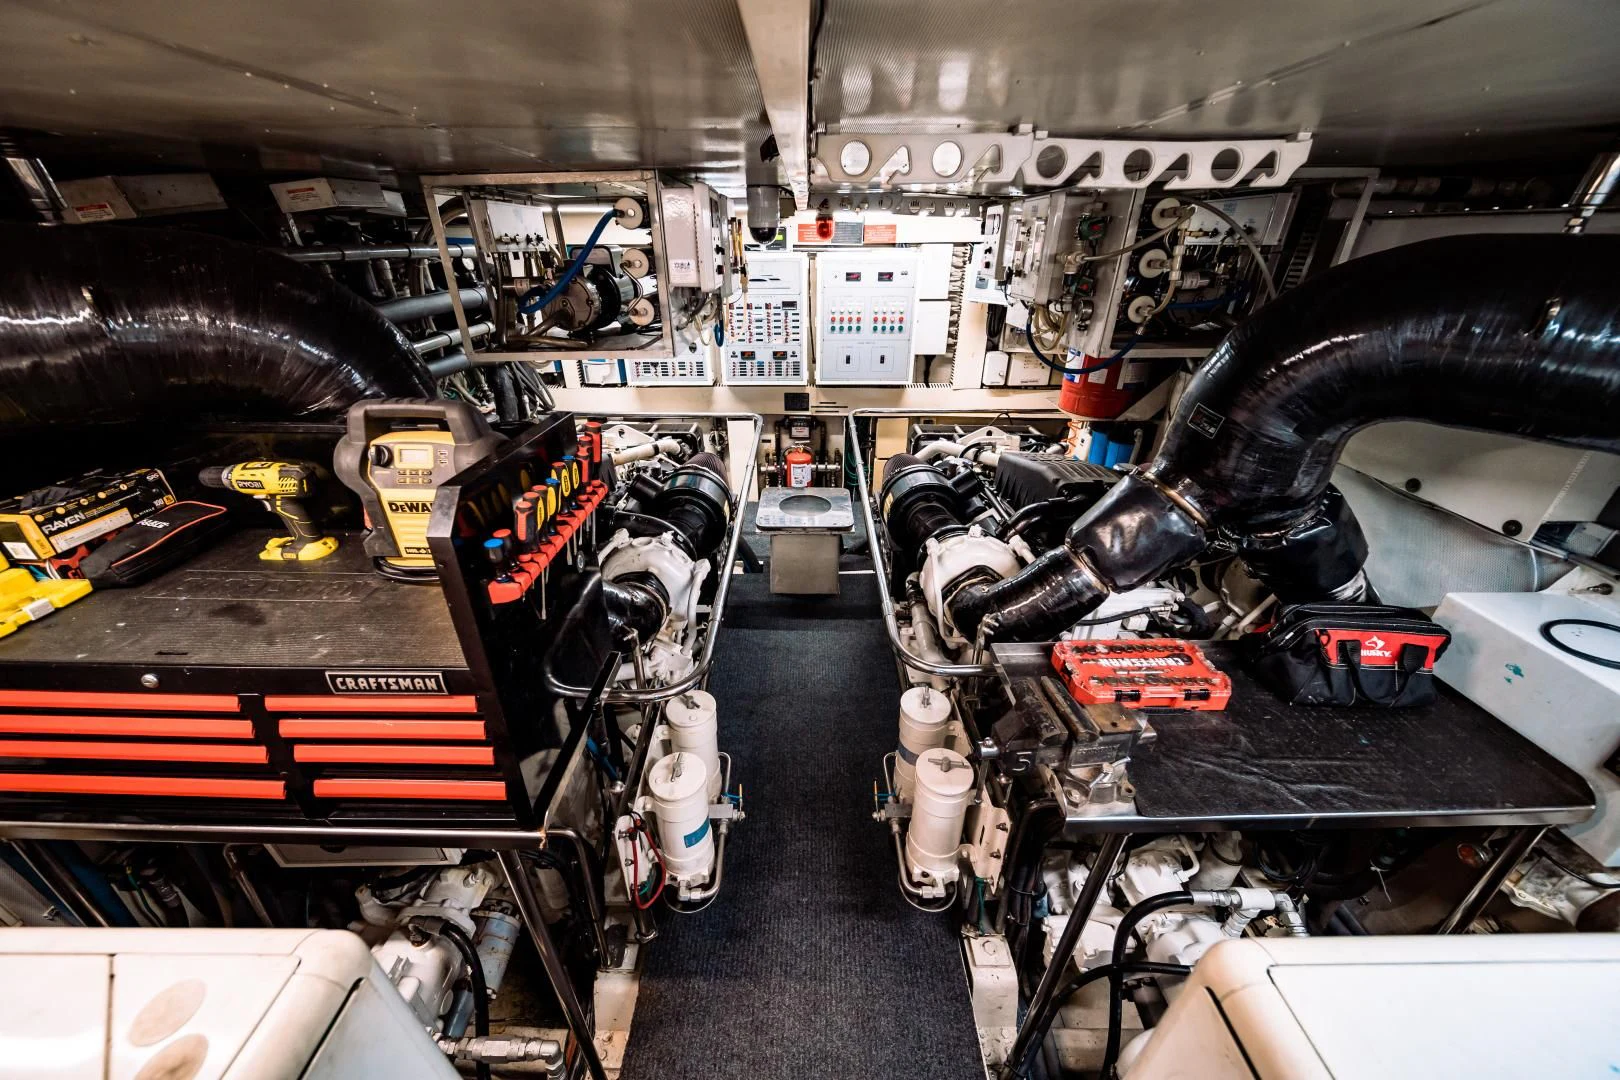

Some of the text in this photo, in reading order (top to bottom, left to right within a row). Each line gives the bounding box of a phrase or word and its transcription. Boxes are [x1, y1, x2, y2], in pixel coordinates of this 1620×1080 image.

[237, 480, 263, 489] RYOBI
[41, 511, 86, 534] RAVEN
[1361, 649, 1392, 657] HUSKY
[1098, 657, 1185, 667] CRAFTSMAN
[335, 677, 438, 690] CRAFTSMAN
